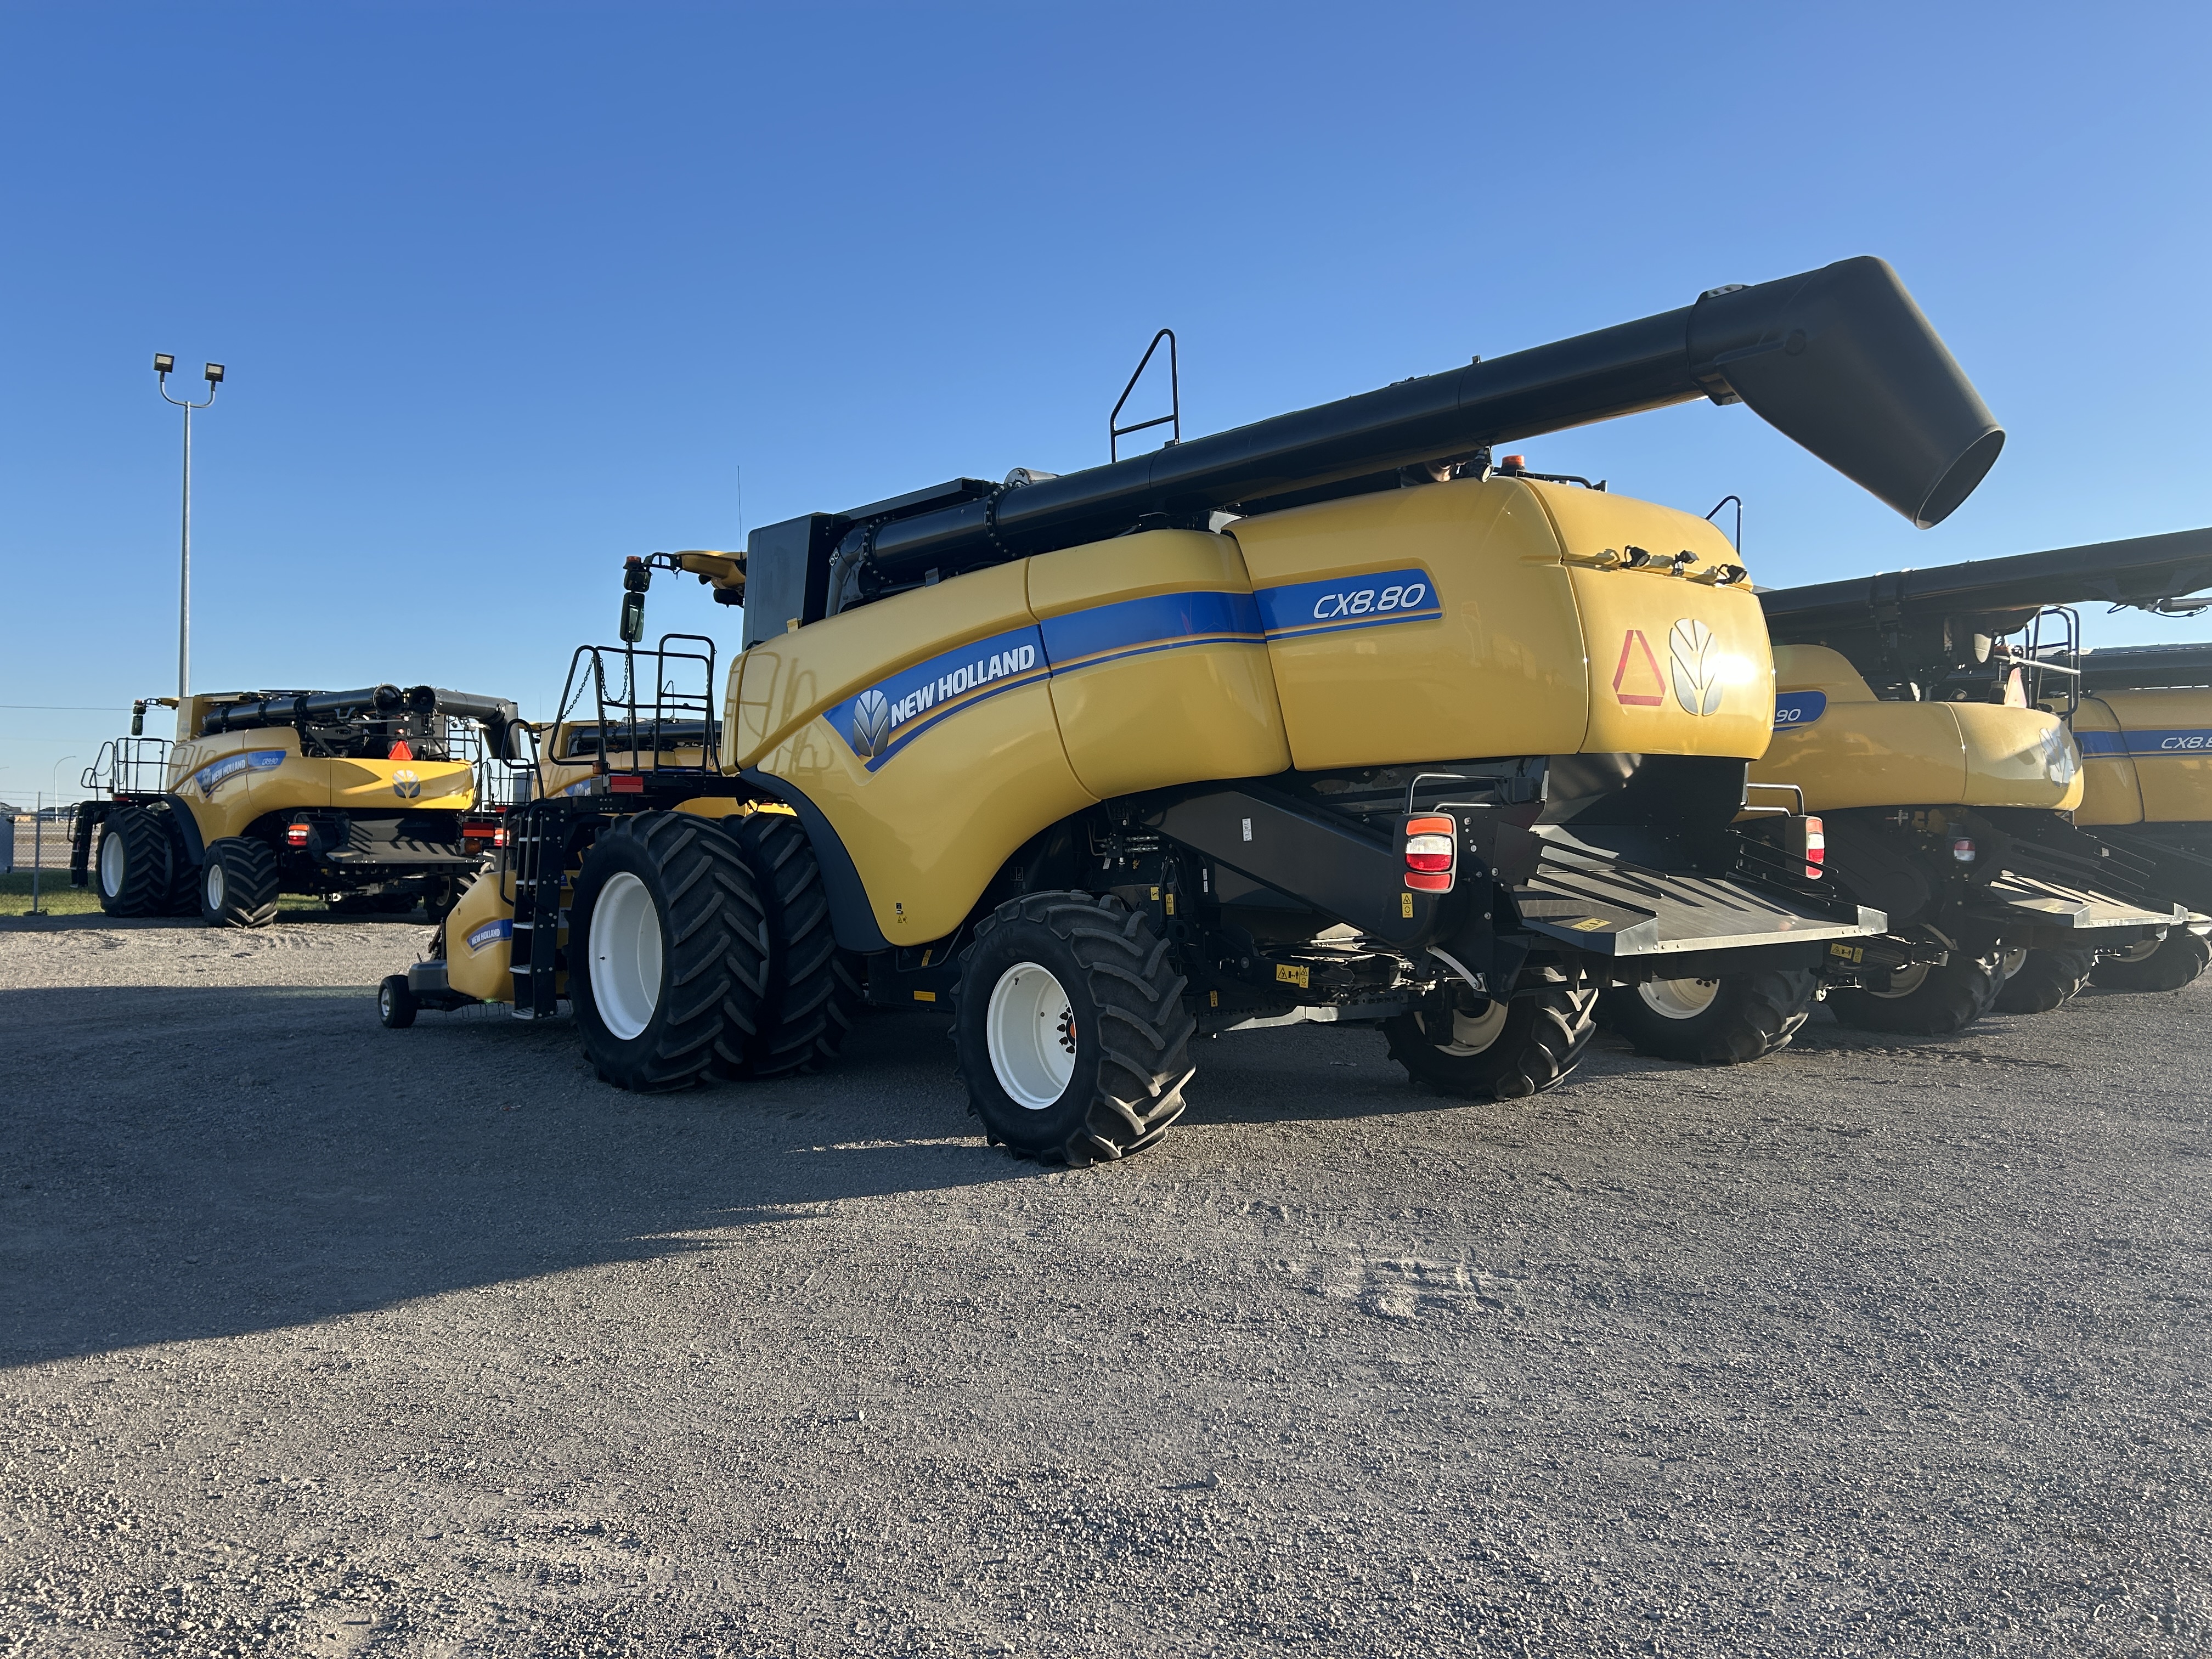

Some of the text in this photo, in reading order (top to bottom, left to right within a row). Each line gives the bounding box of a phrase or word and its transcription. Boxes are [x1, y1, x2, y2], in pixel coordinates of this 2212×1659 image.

[1313, 583, 1426, 619] CX8.80
[891, 645, 1035, 728] NEW HOLLAND
[212, 759, 246, 785] NEW HOLLAND
[471, 928, 500, 946] NEW HOLLAND
